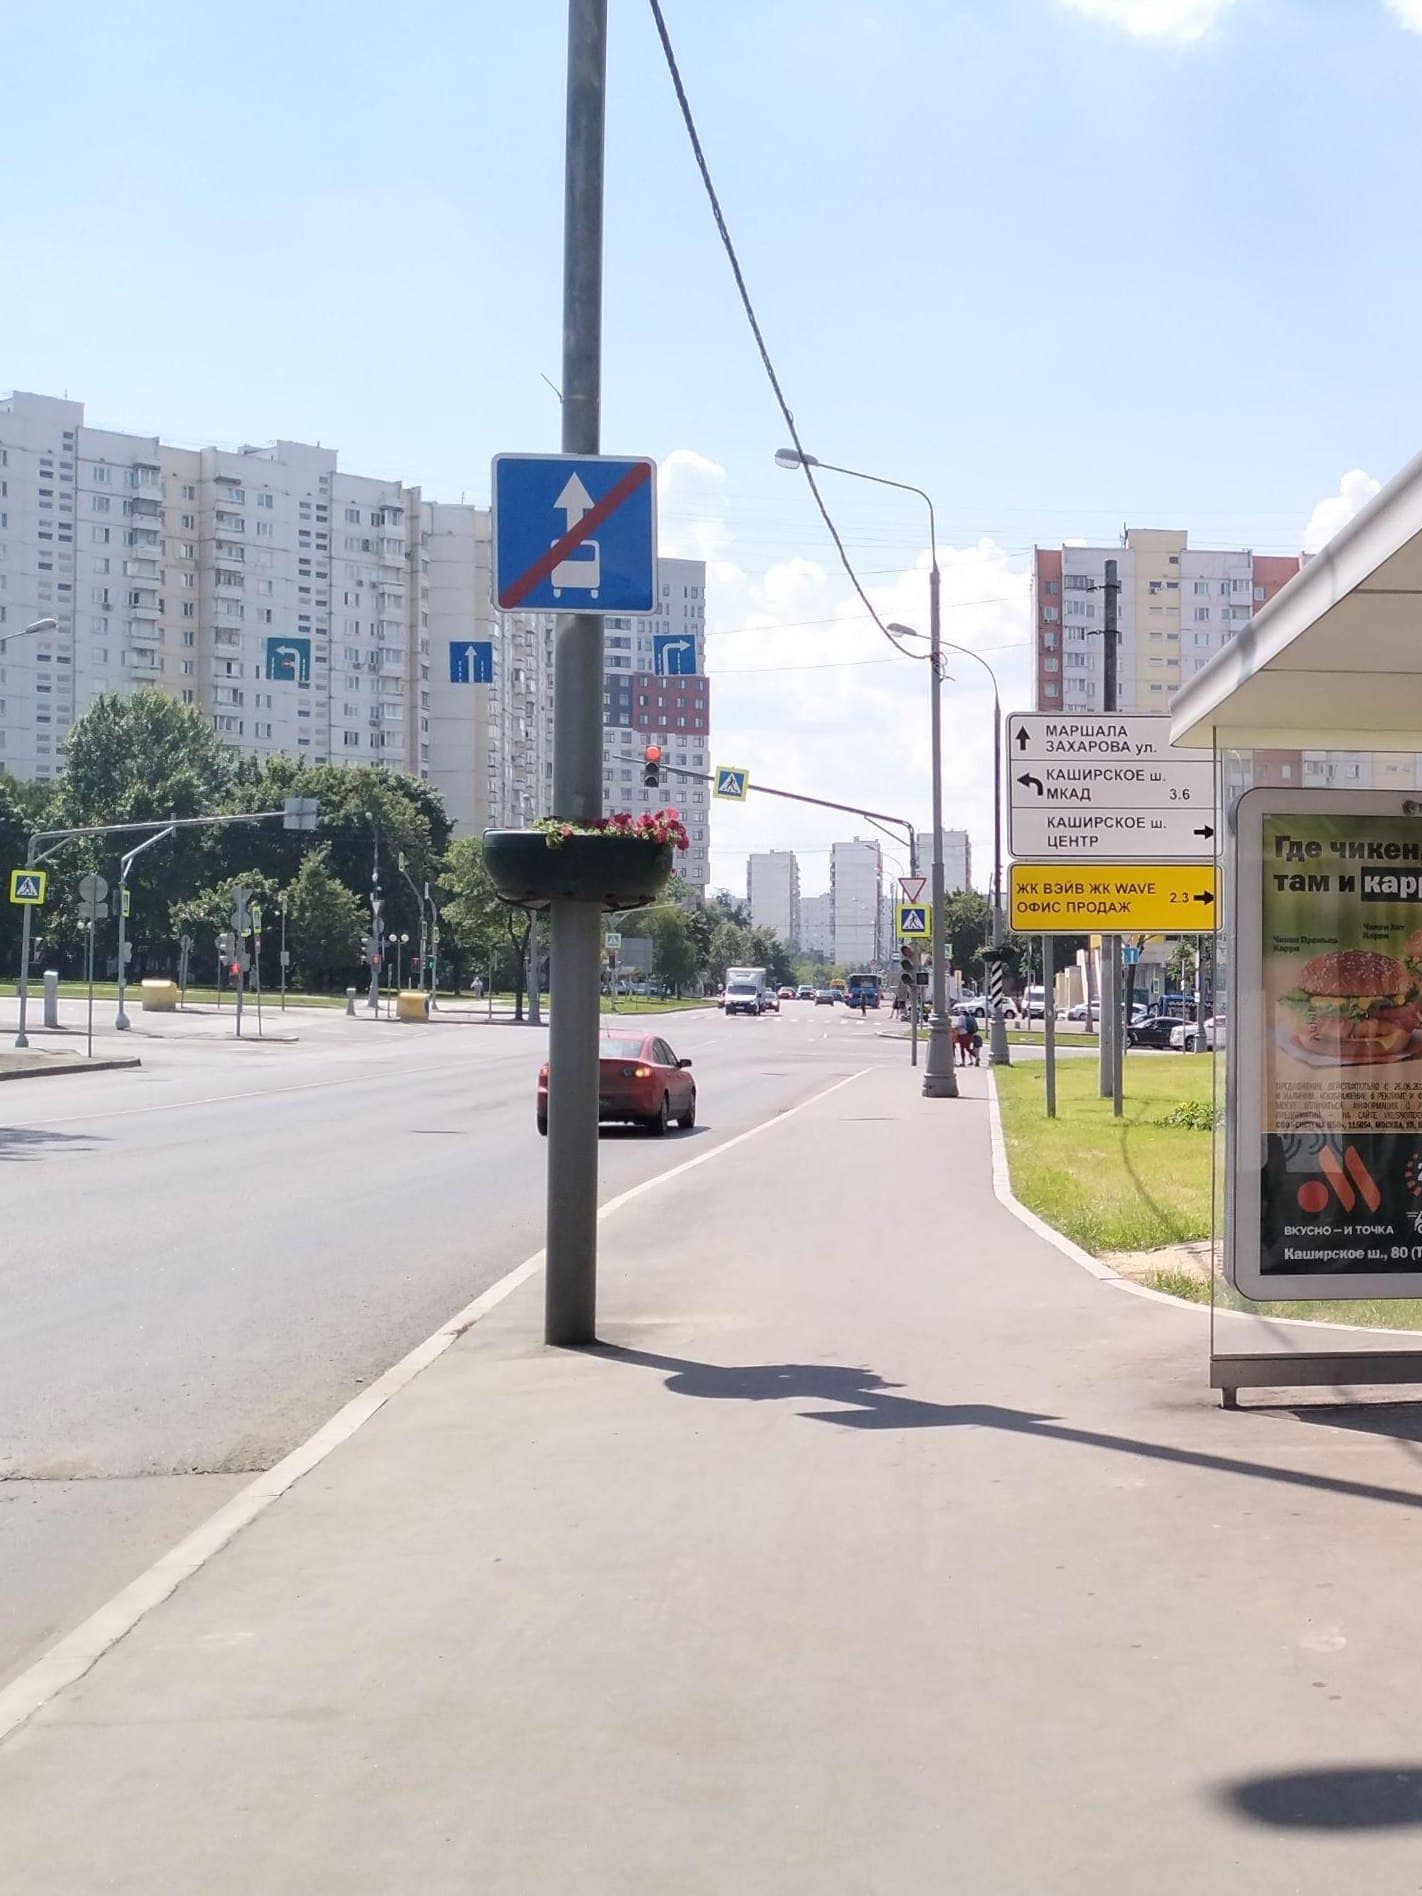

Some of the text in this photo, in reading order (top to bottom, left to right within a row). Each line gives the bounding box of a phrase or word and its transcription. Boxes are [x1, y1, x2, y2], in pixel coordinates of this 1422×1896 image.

[1046, 725, 1128, 737] МАРШАЛА
[1046, 740, 1157, 756] ЗАХАРОВА ул.
[1046, 769, 1166, 782] КАШИРСКОЕ ш.
[1046, 788, 1191, 801] МКАД 3.6
[1047, 817, 1167, 829] КАШИРСКОЕ ш.
[1047, 835, 1099, 849] ЦЕНТР
[1273, 835, 1321, 862] Где
[1017, 882, 1157, 895] ЖК ВЭЙВ ЖК WAVE
[1273, 874, 1329, 892] там
[1338, 874, 1355, 892] и
[1169, 892, 1190, 904] 2.3
[1016, 901, 1131, 914] ОФИС ПРОДАЖ
[1284, 1225, 1332, 1236] ВКУСНО
[1344, 1225, 1353, 1236] И
[1355, 1225, 1394, 1236] ТОЧКА
[1284, 1247, 1366, 1263] Каширское
[1390, 1247, 1409, 1259] 80
